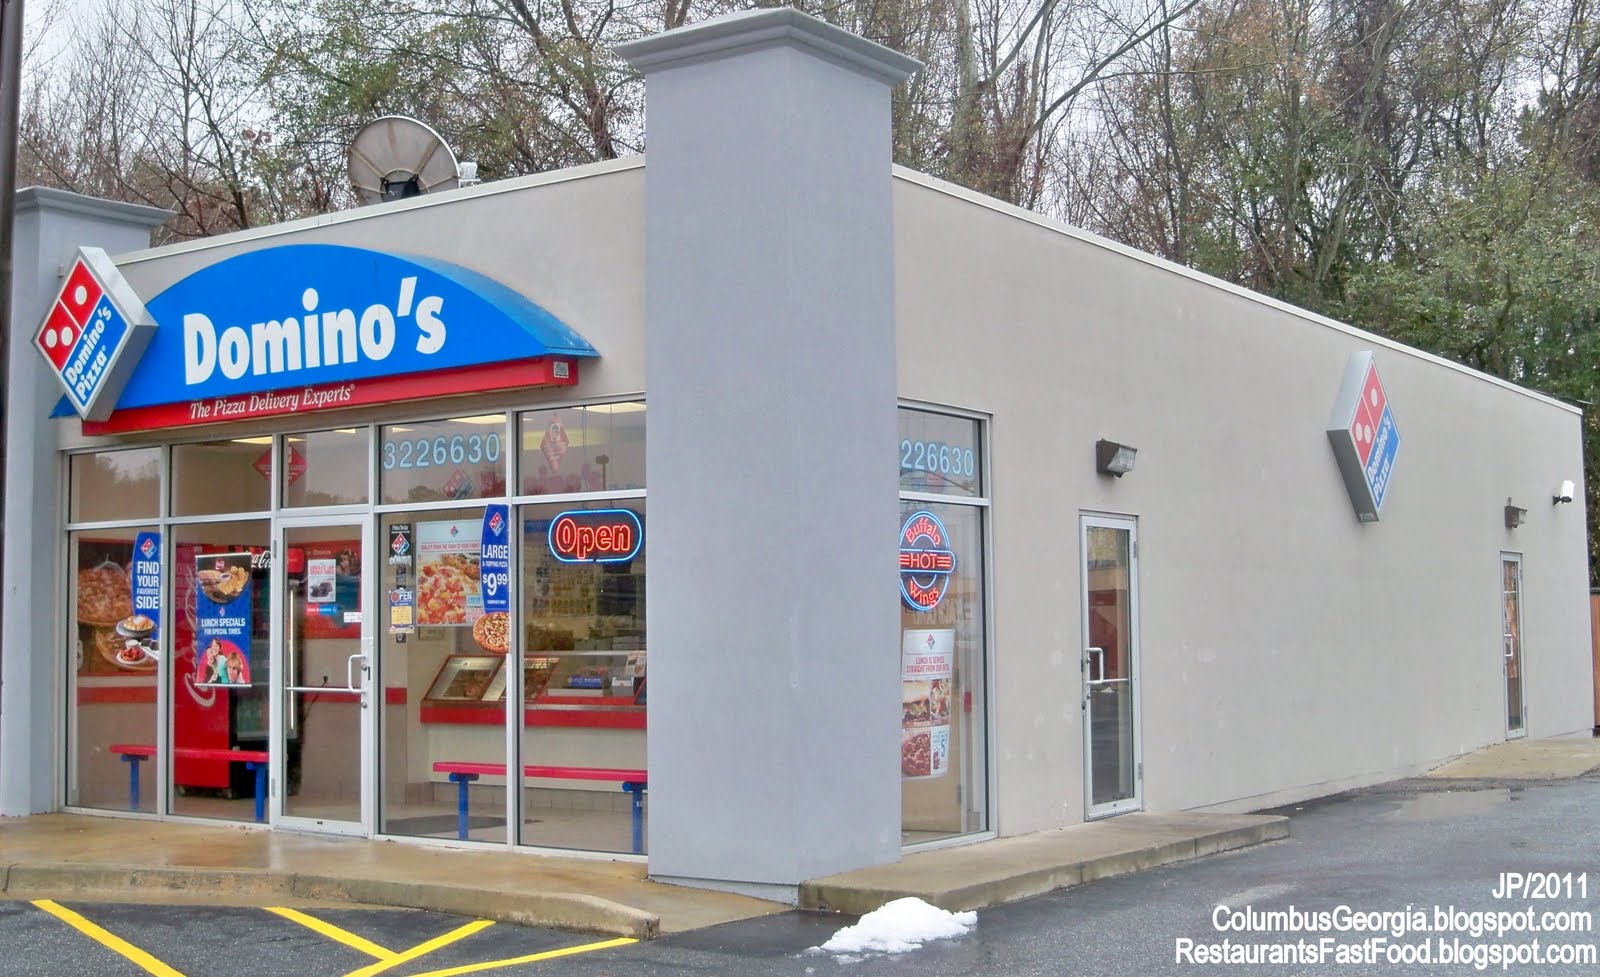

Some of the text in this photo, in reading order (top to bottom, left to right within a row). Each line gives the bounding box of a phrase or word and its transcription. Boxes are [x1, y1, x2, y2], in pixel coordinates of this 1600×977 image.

[65, 306, 112, 387] Domino's
[183, 276, 447, 386] Domino's
[75, 350, 107, 401] Pizza
[190, 385, 351, 420] The Pizza Delivery Experts
[383, 432, 501, 470] 3226630
[901, 439, 974, 477] 226630
[1367, 416, 1391, 485] Domino's
[1373, 457, 1390, 503] Pizza
[556, 518, 631, 560] Open
[905, 517, 941, 545] Buffalo
[482, 544, 508, 559] LARGE
[910, 553, 938, 569] HOT
[137, 561, 160, 575] FIND
[137, 575, 160, 588] YOUR
[136, 588, 159, 596] FAVORITE
[136, 596, 159, 609] SIDE
[910, 579, 939, 608] Wings
[201, 617, 246, 627] LUNCH SPECIALS
